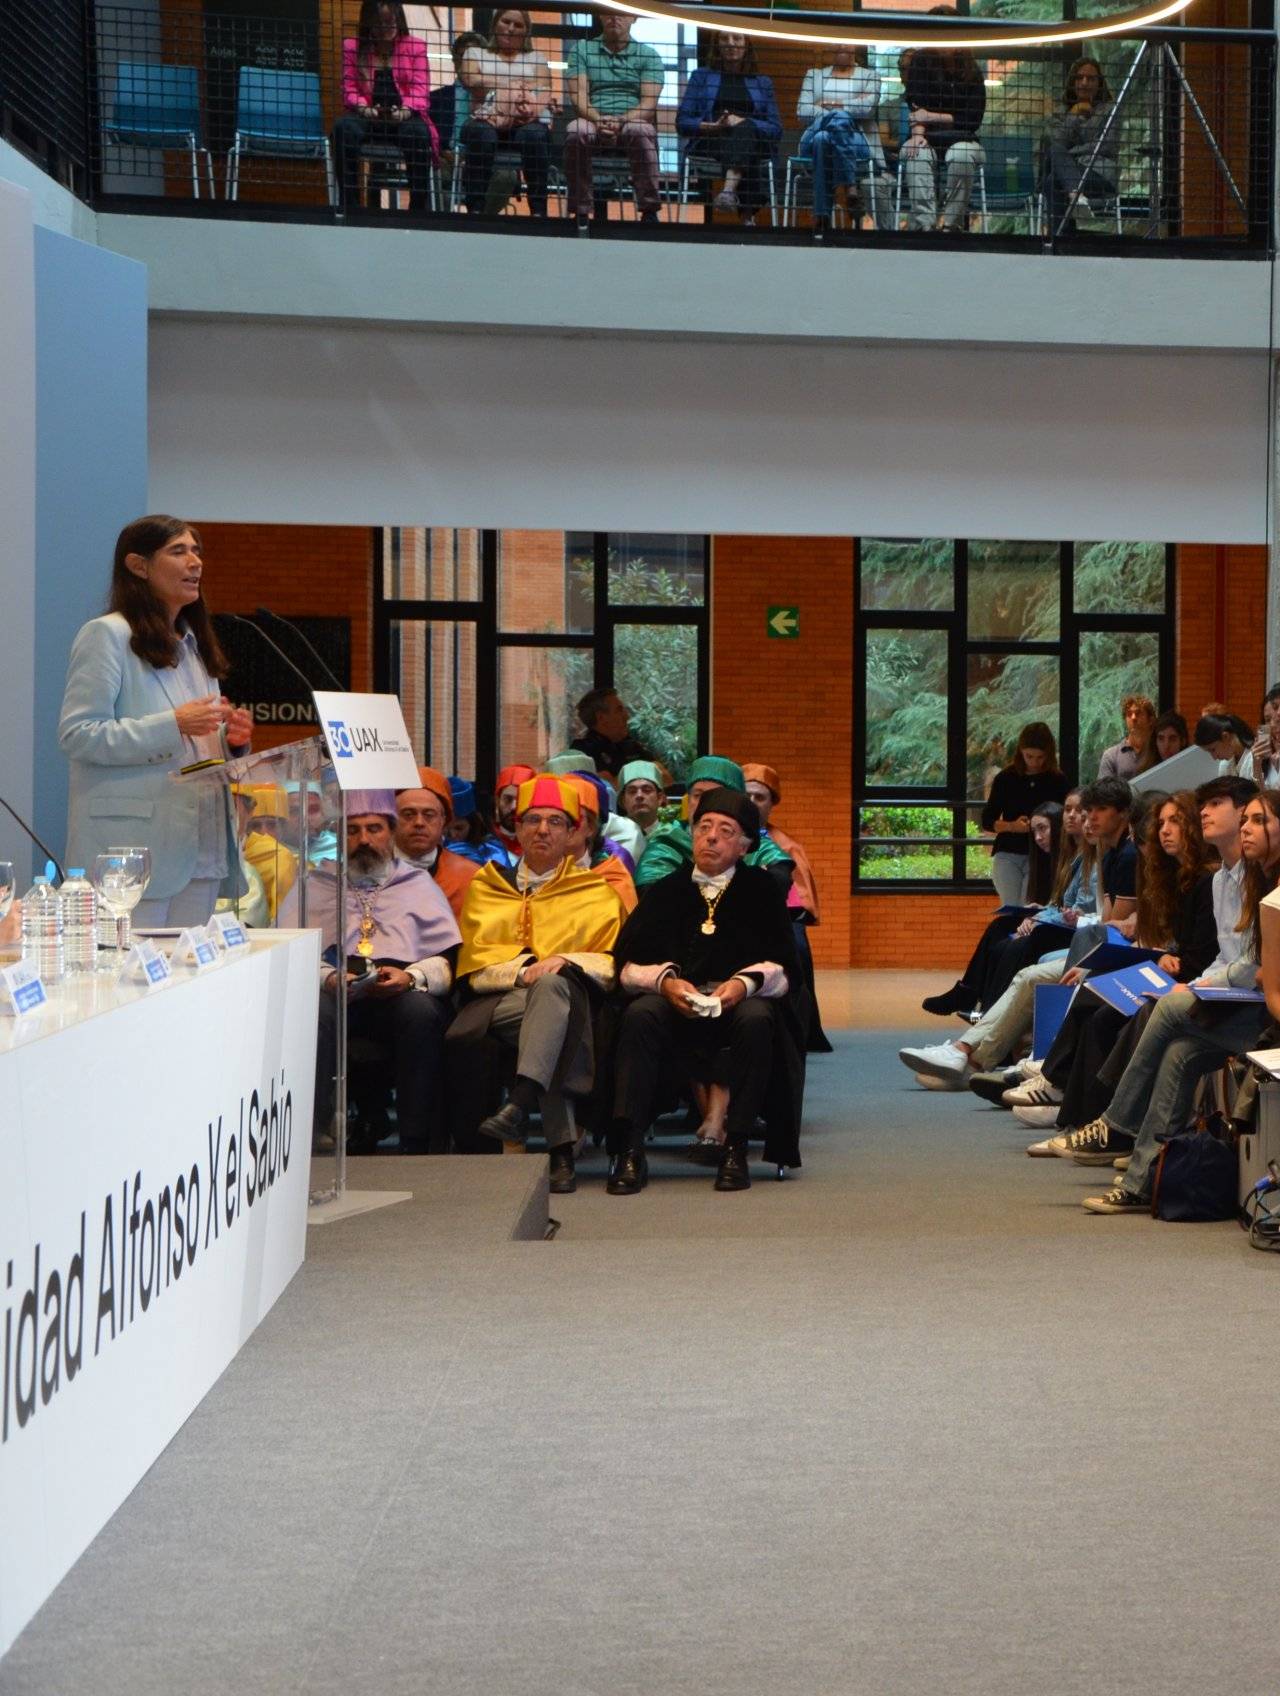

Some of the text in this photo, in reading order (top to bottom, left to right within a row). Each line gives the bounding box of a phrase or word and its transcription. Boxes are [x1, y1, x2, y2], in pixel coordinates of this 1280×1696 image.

[349, 727, 383, 752] UAX
[95, 1163, 200, 1357] Alfonso
[205, 1115, 222, 1250] X
[225, 1097, 243, 1229] el
[246, 1068, 292, 1208] Sabio
